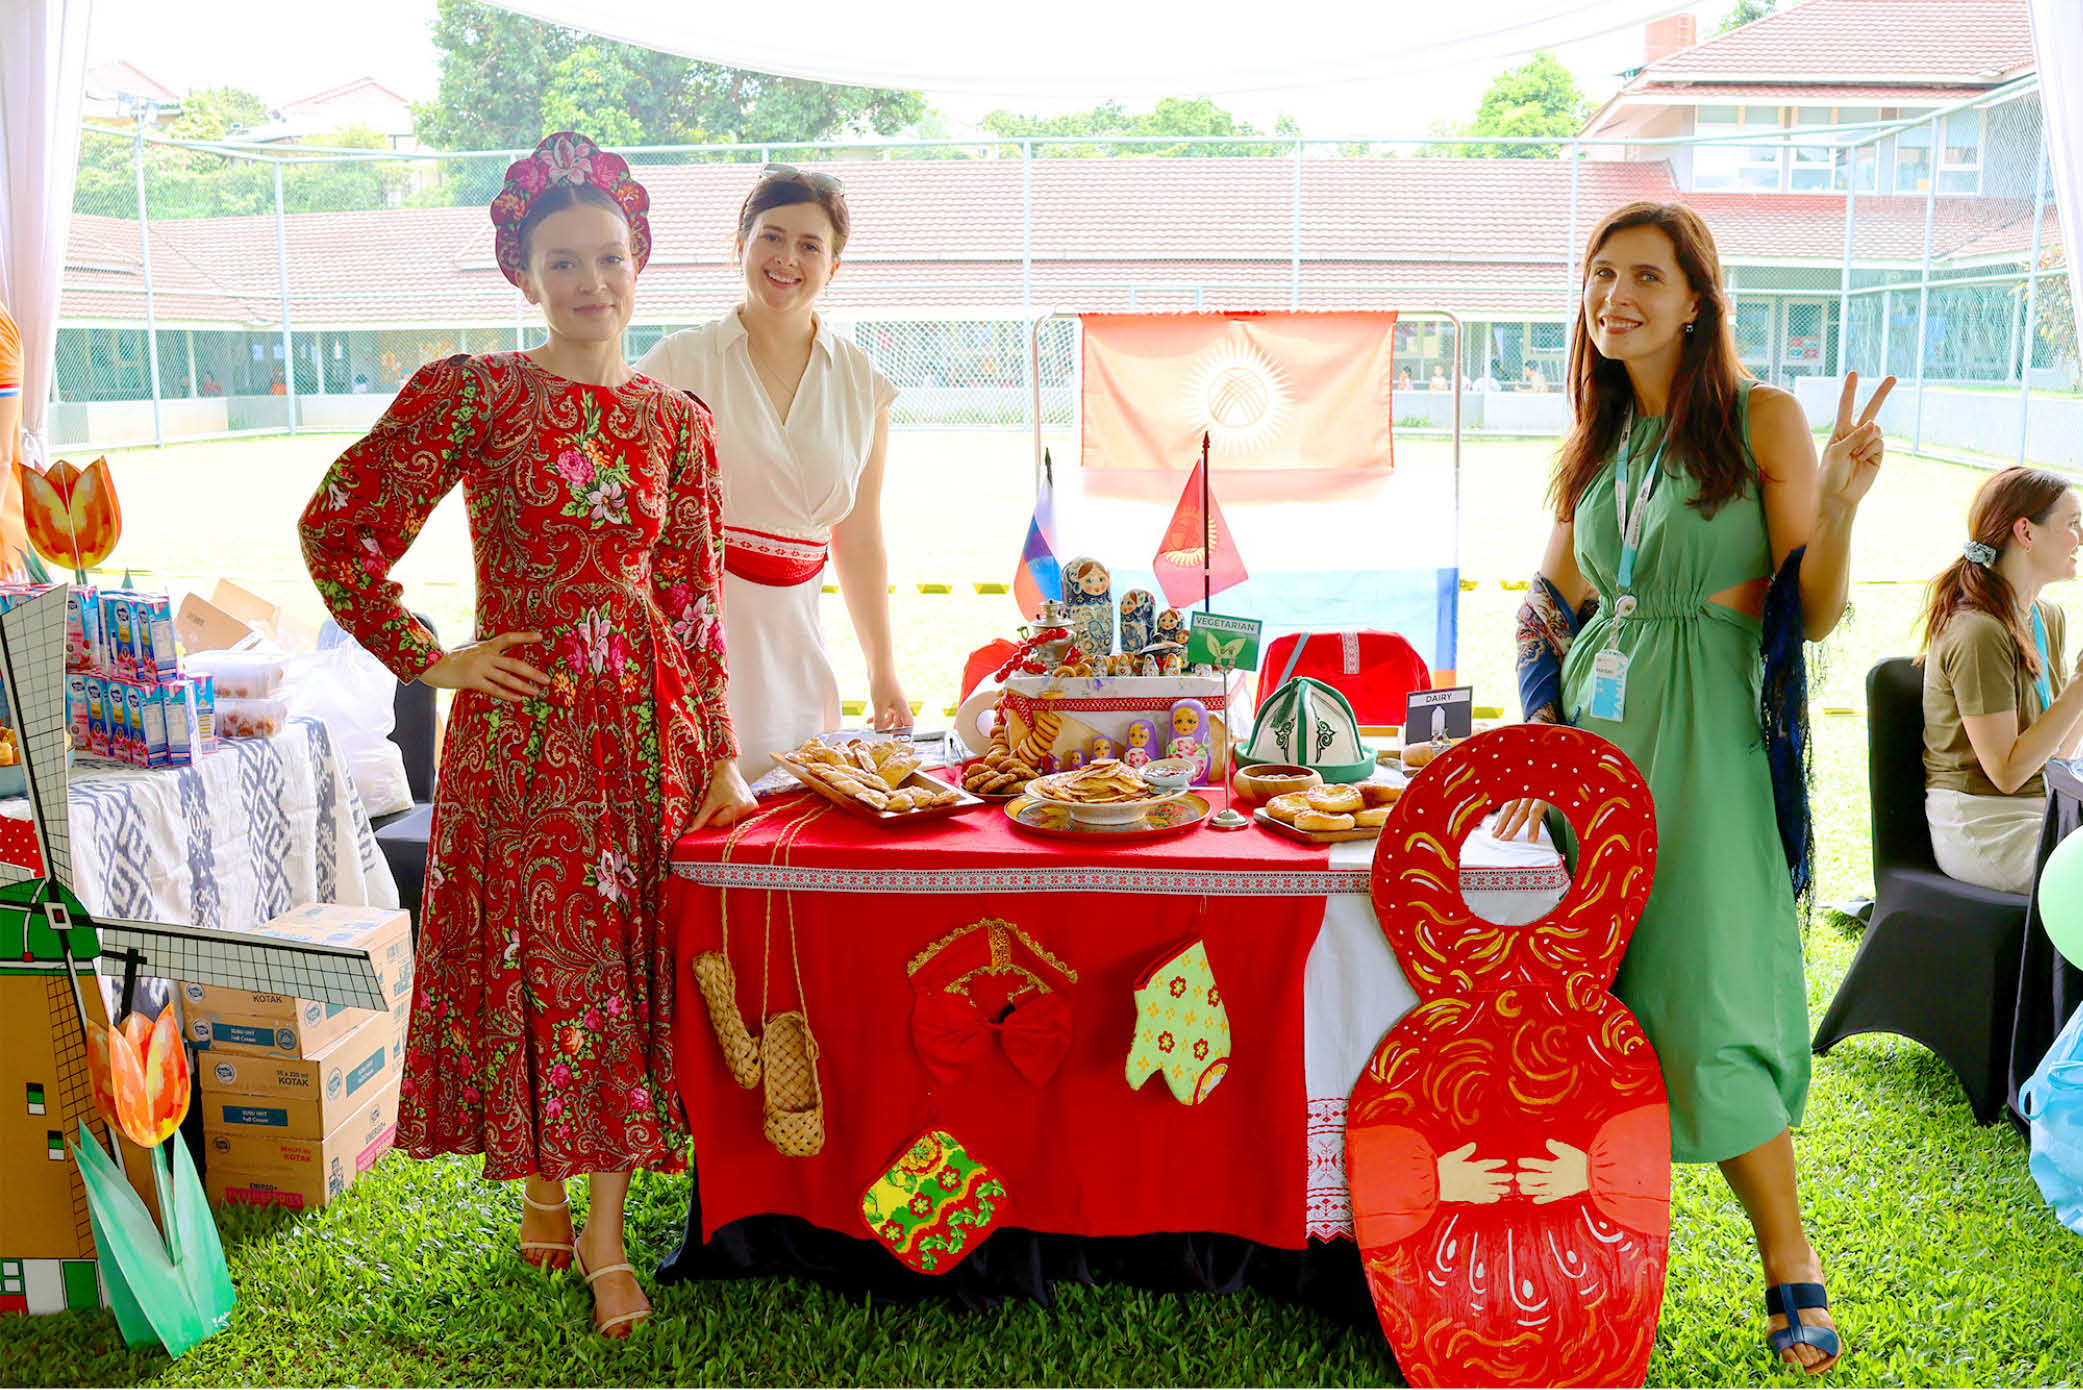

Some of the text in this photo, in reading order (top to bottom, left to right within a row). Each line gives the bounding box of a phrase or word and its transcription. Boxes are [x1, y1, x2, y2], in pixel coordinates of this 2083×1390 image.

[1196, 616, 1255, 632] VEGETARIAN
[1425, 692, 1452, 703] DAIRY
[253, 994, 283, 1004] KOTAK
[279, 1077, 309, 1087] KOTAK
